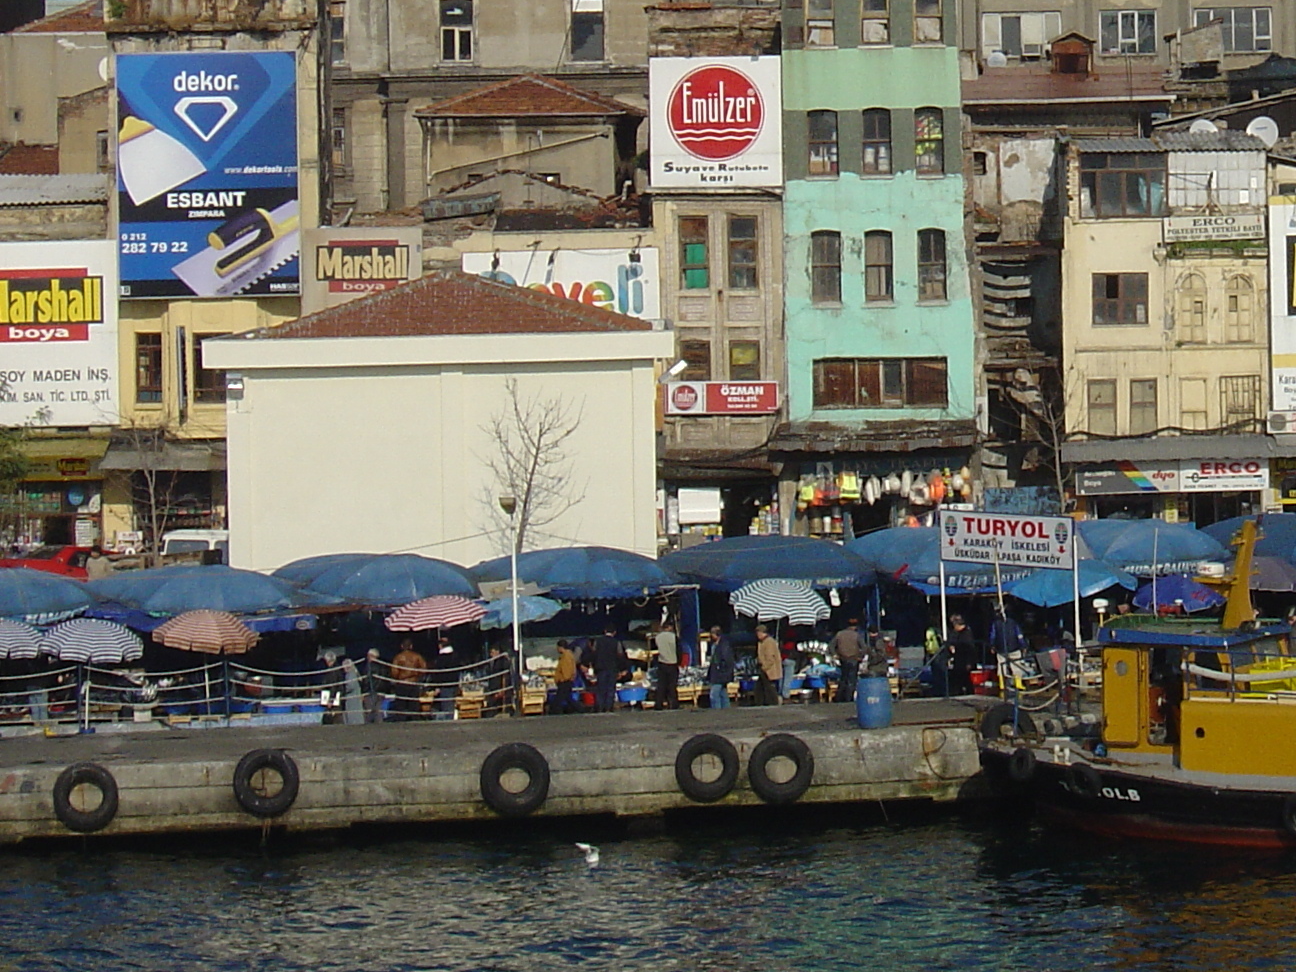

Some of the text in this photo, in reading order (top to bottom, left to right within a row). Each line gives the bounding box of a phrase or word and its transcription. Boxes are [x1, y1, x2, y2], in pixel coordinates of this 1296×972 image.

[174, 70, 235, 92] dekor
[682, 81, 756, 124] Emülzer
[166, 191, 246, 209] ESBANT
[1192, 217, 1236, 227] ERCO
[121, 241, 189, 254] 282 79 22
[317, 247, 408, 280] Marshall
[342, 281, 385, 294] boya
[8, 326, 70, 342] boya
[33, 369, 81, 382] MADEN
[720, 384, 764, 395] ÖZMAN
[1200, 462, 1261, 475] ERCO
[1152, 470, 1175, 482] dyo
[963, 517, 1050, 539] TURYOL
